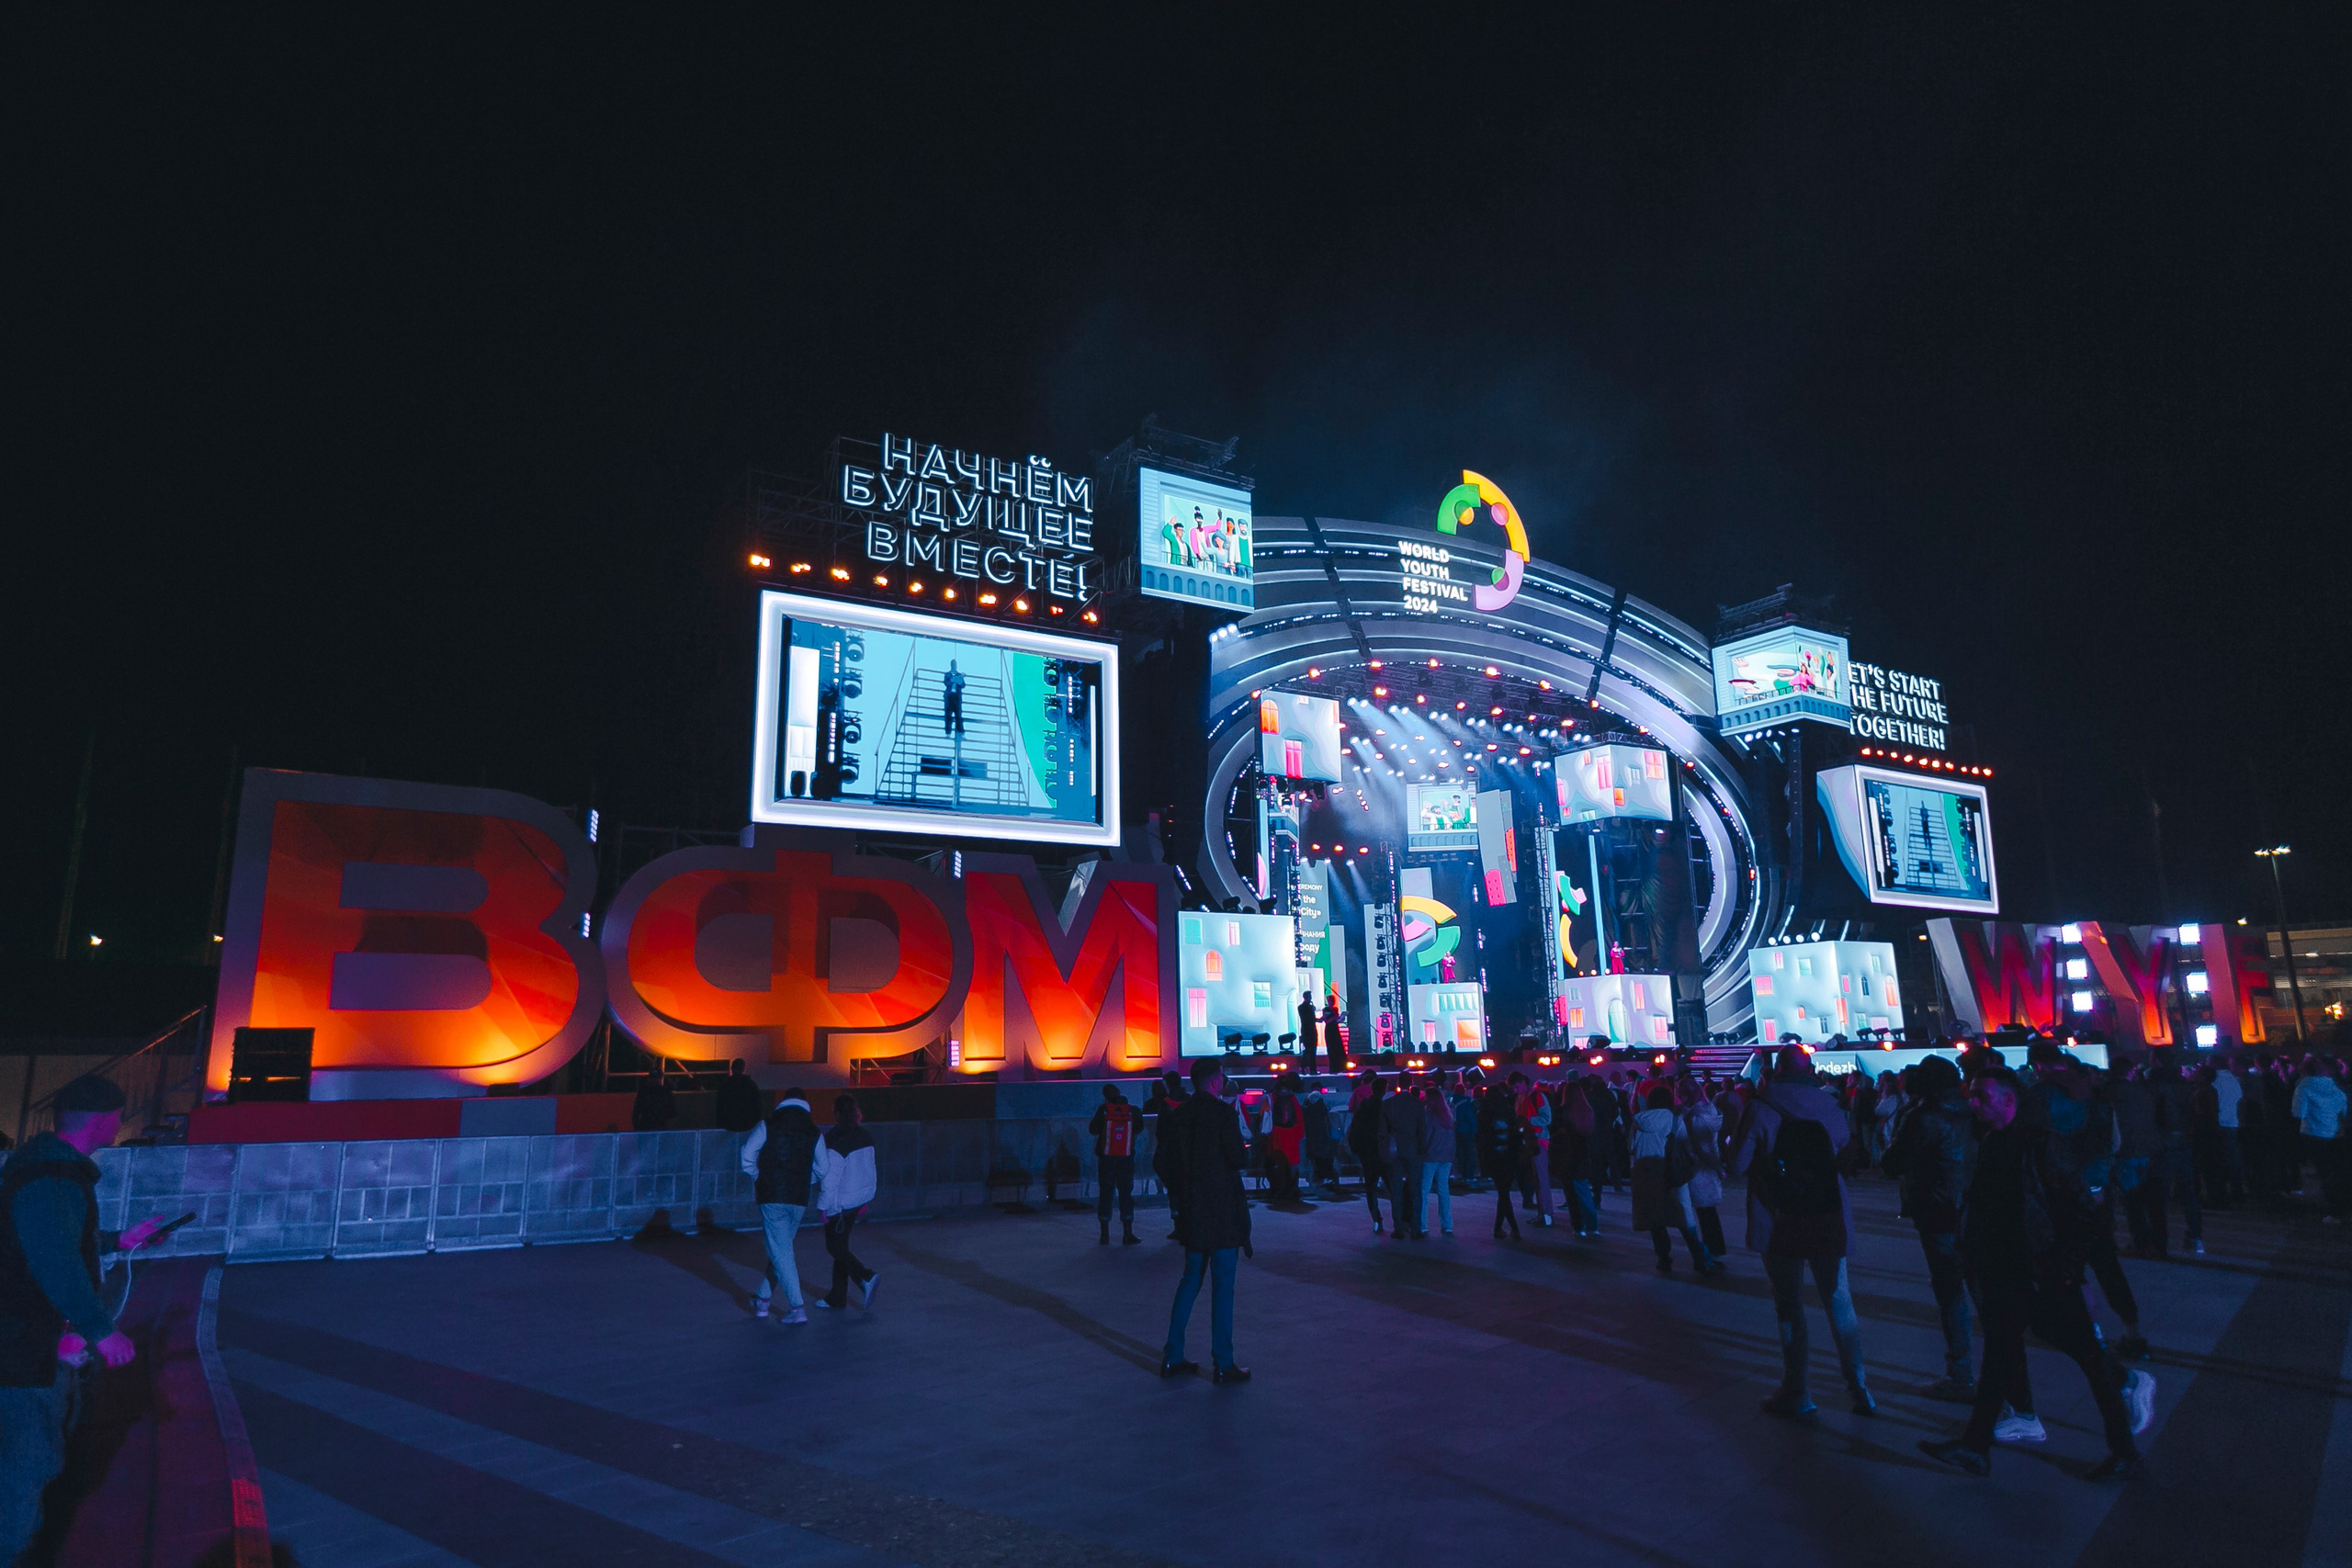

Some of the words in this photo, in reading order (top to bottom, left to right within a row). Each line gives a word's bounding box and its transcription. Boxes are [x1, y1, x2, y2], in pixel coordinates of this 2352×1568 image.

[883, 433, 1093, 513] НАЧНЁМ
[843, 465, 1093, 551] БУДУЩЕЕ
[867, 521, 1089, 602] ВМЕСТЕ!
[1398, 540, 1450, 563] WORLD
[1400, 558, 1450, 581] YOUTH
[1403, 577, 1469, 602] FESTIVAL
[1403, 594, 1439, 614] 2024
[1848, 661, 1885, 689] ET'S
[1888, 670, 1940, 701] START
[1849, 683, 1878, 711] HE
[1880, 690, 1949, 725] FUTURE
[1303, 895, 1317, 905] the
[202, 768, 1180, 1102] ВФМ
[1928, 918, 2271, 1047] WYF
[1815, 1060, 1857, 1074] lodezh
